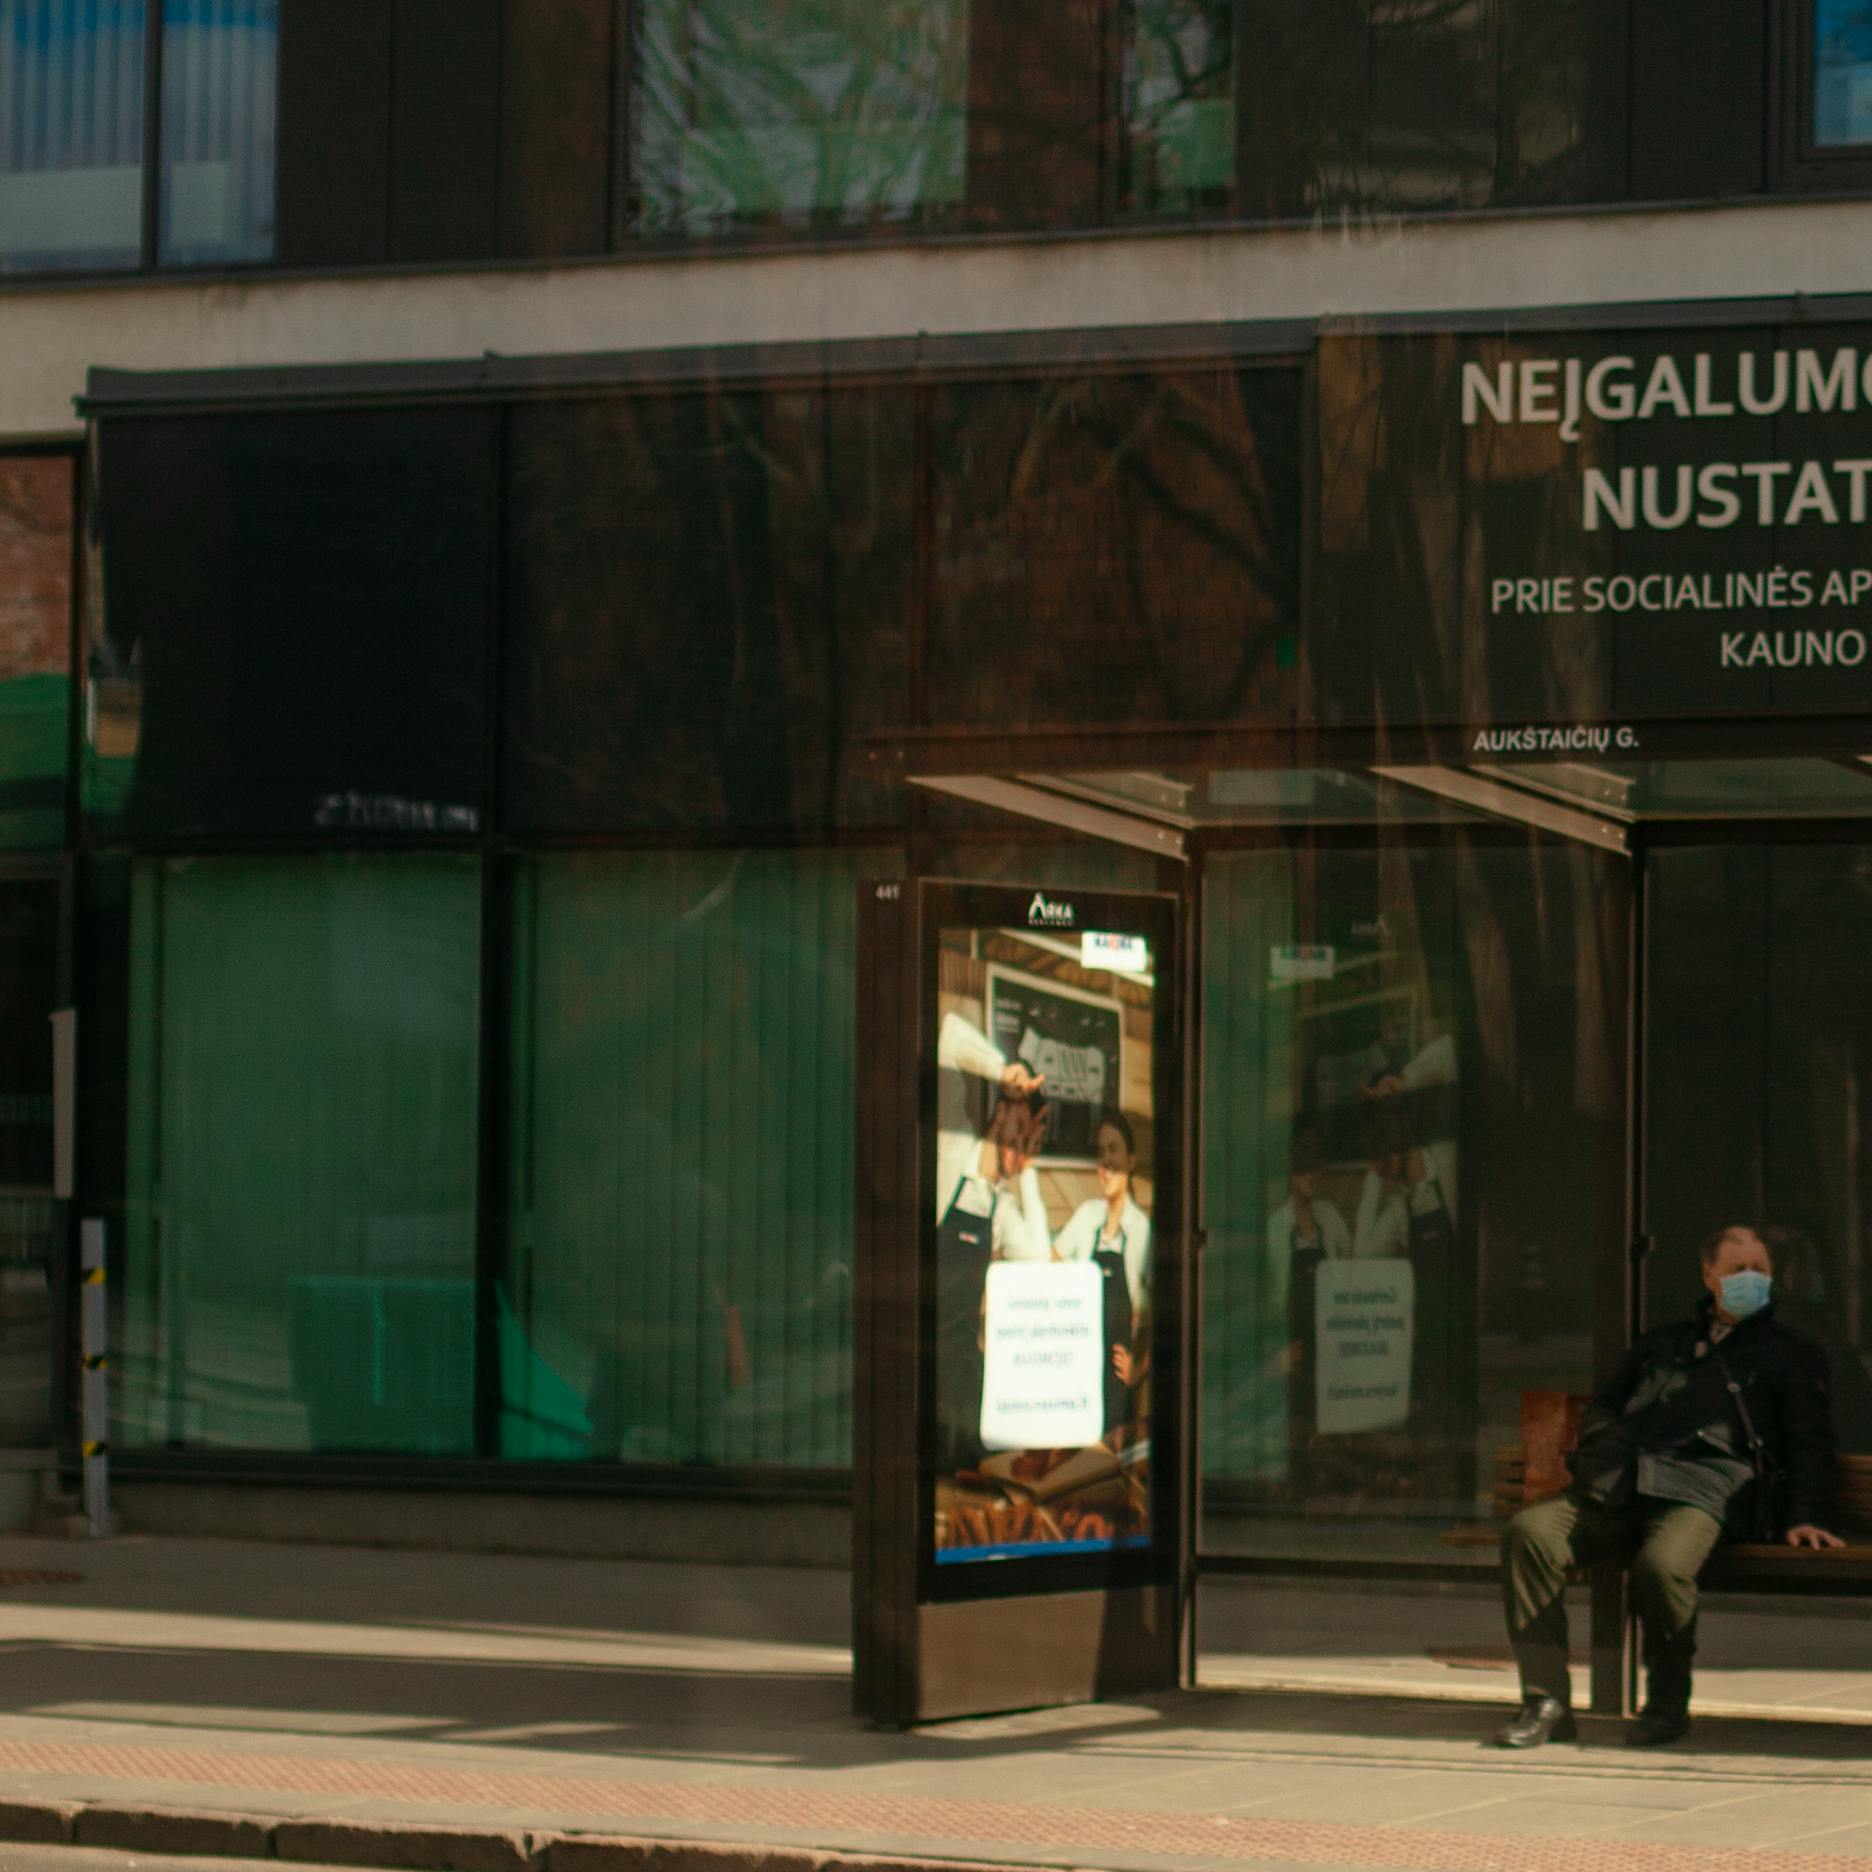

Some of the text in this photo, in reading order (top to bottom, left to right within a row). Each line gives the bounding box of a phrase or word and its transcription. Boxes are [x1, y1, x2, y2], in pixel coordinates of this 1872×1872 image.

[1491, 577, 1574, 614] PRIE
[1582, 565, 1814, 612] SOCIALINĖS
[1720, 629, 1867, 668] KAUNO
[1473, 725, 1640, 754] AUKŠTAIČIŲ G.
